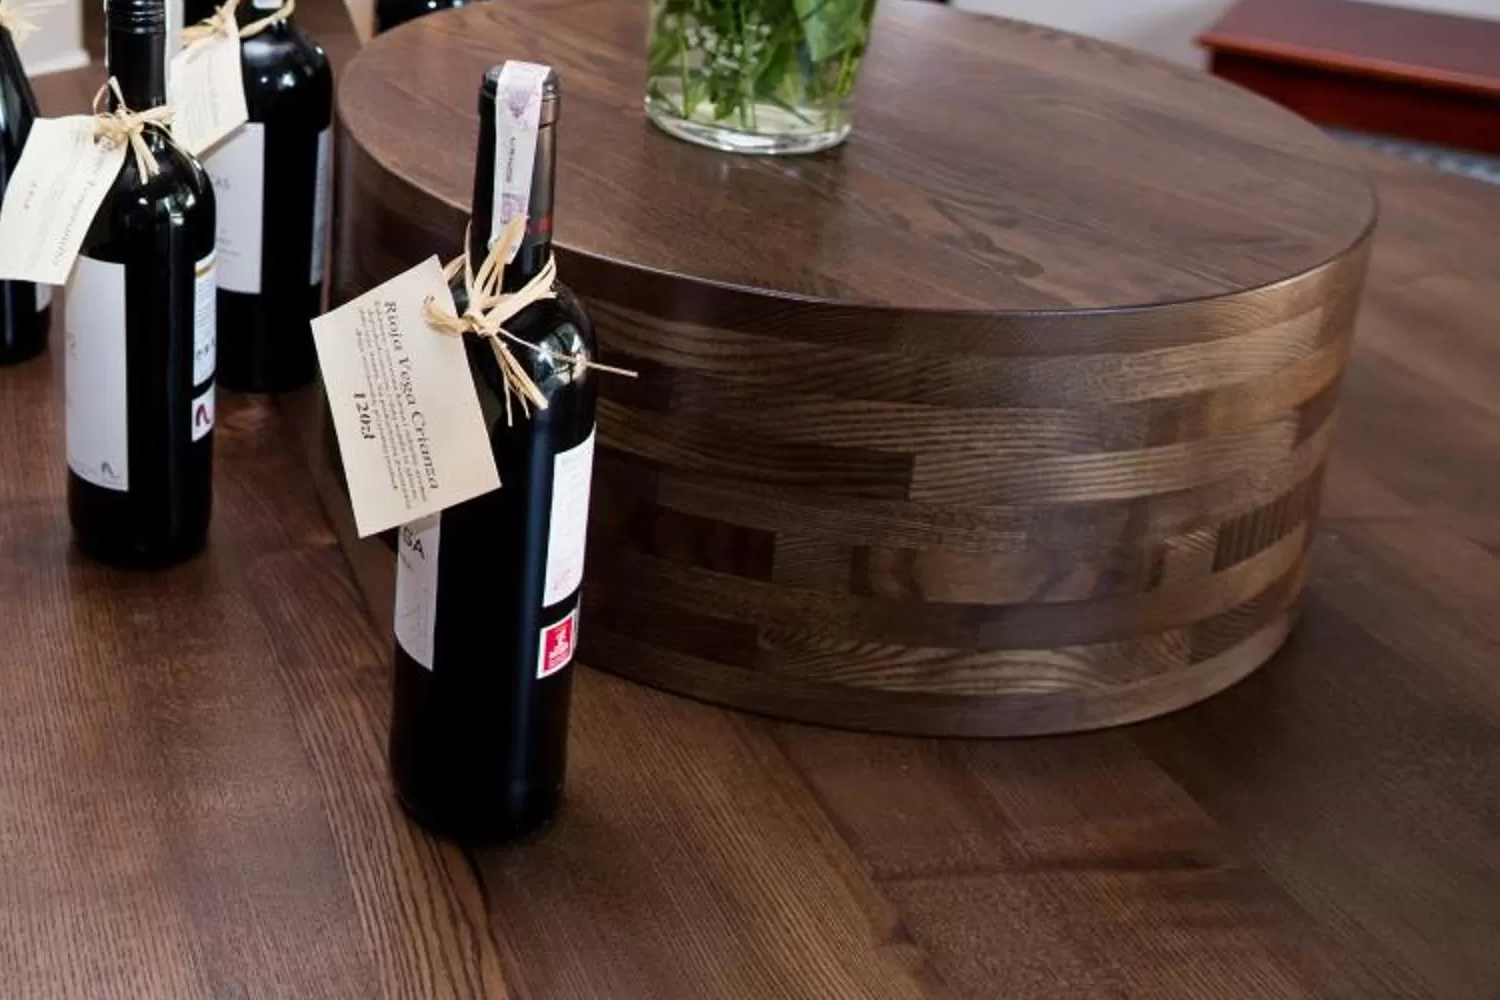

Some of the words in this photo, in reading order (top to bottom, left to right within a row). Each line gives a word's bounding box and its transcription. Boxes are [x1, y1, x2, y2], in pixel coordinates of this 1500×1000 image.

[352, 390, 376, 441] 120zł
[382, 300, 402, 352] Rioja
[397, 356, 417, 406] Vega
[410, 410, 441, 490] Crianza
